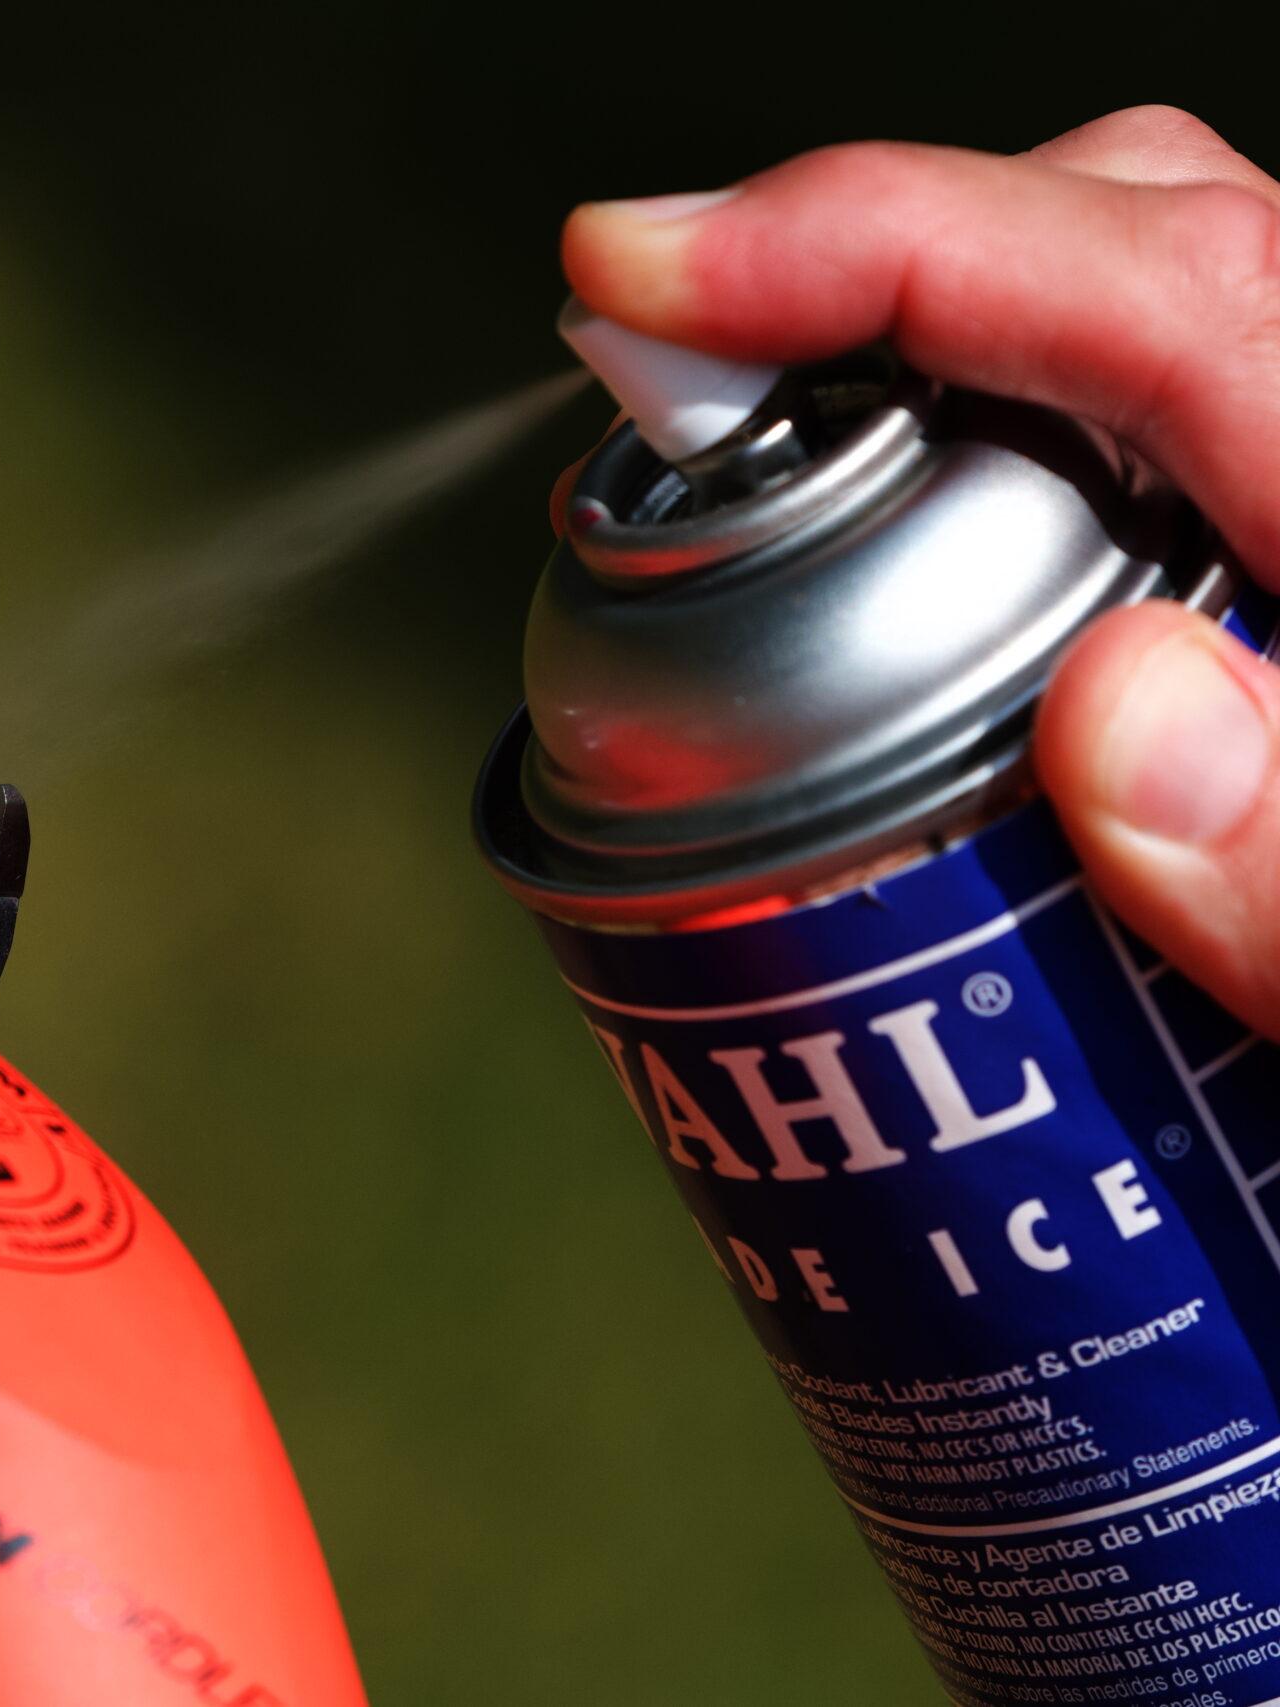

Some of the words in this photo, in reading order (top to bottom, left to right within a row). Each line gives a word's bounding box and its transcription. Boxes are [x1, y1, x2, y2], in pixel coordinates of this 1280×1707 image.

[927, 1159, 1163, 1297] ICE
[788, 1362, 885, 1406] Coolant,
[882, 1363, 1034, 1403] Lubricant
[1036, 1350, 1070, 1379] &
[1069, 1297, 1206, 1368] Cleaner
[828, 1401, 915, 1434] Blades
[913, 1394, 1052, 1434] Instantly
[919, 1441, 945, 1461] NO
[945, 1437, 992, 1459] CFC'S
[991, 1432, 1020, 1452] OR
[1019, 1414, 1095, 1449] HCFC'S.
[881, 1462, 912, 1483] NOT
[911, 1465, 963, 1484] HARM
[961, 1460, 1012, 1483] MOST
[1011, 1439, 1108, 1478] PLASTICS.
[882, 1491, 912, 1510] and
[912, 1492, 994, 1513] additional
[992, 1466, 1130, 1511] Precautionary
[1131, 1417, 1260, 1479] Statements.
[962, 1549, 982, 1574] y
[985, 1537, 1095, 1572] Agente
[1099, 1524, 1144, 1551] de
[929, 1595, 1029, 1628] Cuchilla
[1031, 1602, 1061, 1628] al
[1058, 1580, 1199, 1625] Instante
[943, 1572, 976, 1597] de
[977, 1564, 1131, 1598] cortadora
[1019, 1635, 1046, 1654] NO
[1045, 1625, 1135, 1653] CONTIENE
[1133, 1617, 1170, 1640] CFC
[1168, 1610, 1195, 1632] NI
[1193, 1592, 1255, 1624] HCFC.
[1021, 1659, 1047, 1677] LA
[1044, 1651, 1127, 1677] MAYORÍA
[1124, 1649, 1154, 1669] DE
[1152, 1638, 1191, 1663] LOS
[1188, 1604, 1280, 1653] PLÁSTICO
[1008, 1683, 1056, 1702] sobre
[1054, 1684, 1086, 1703] las
[1086, 1675, 1170, 1701] medidas
[1171, 1667, 1199, 1687] de
[1201, 1640, 1280, 1684] primero
